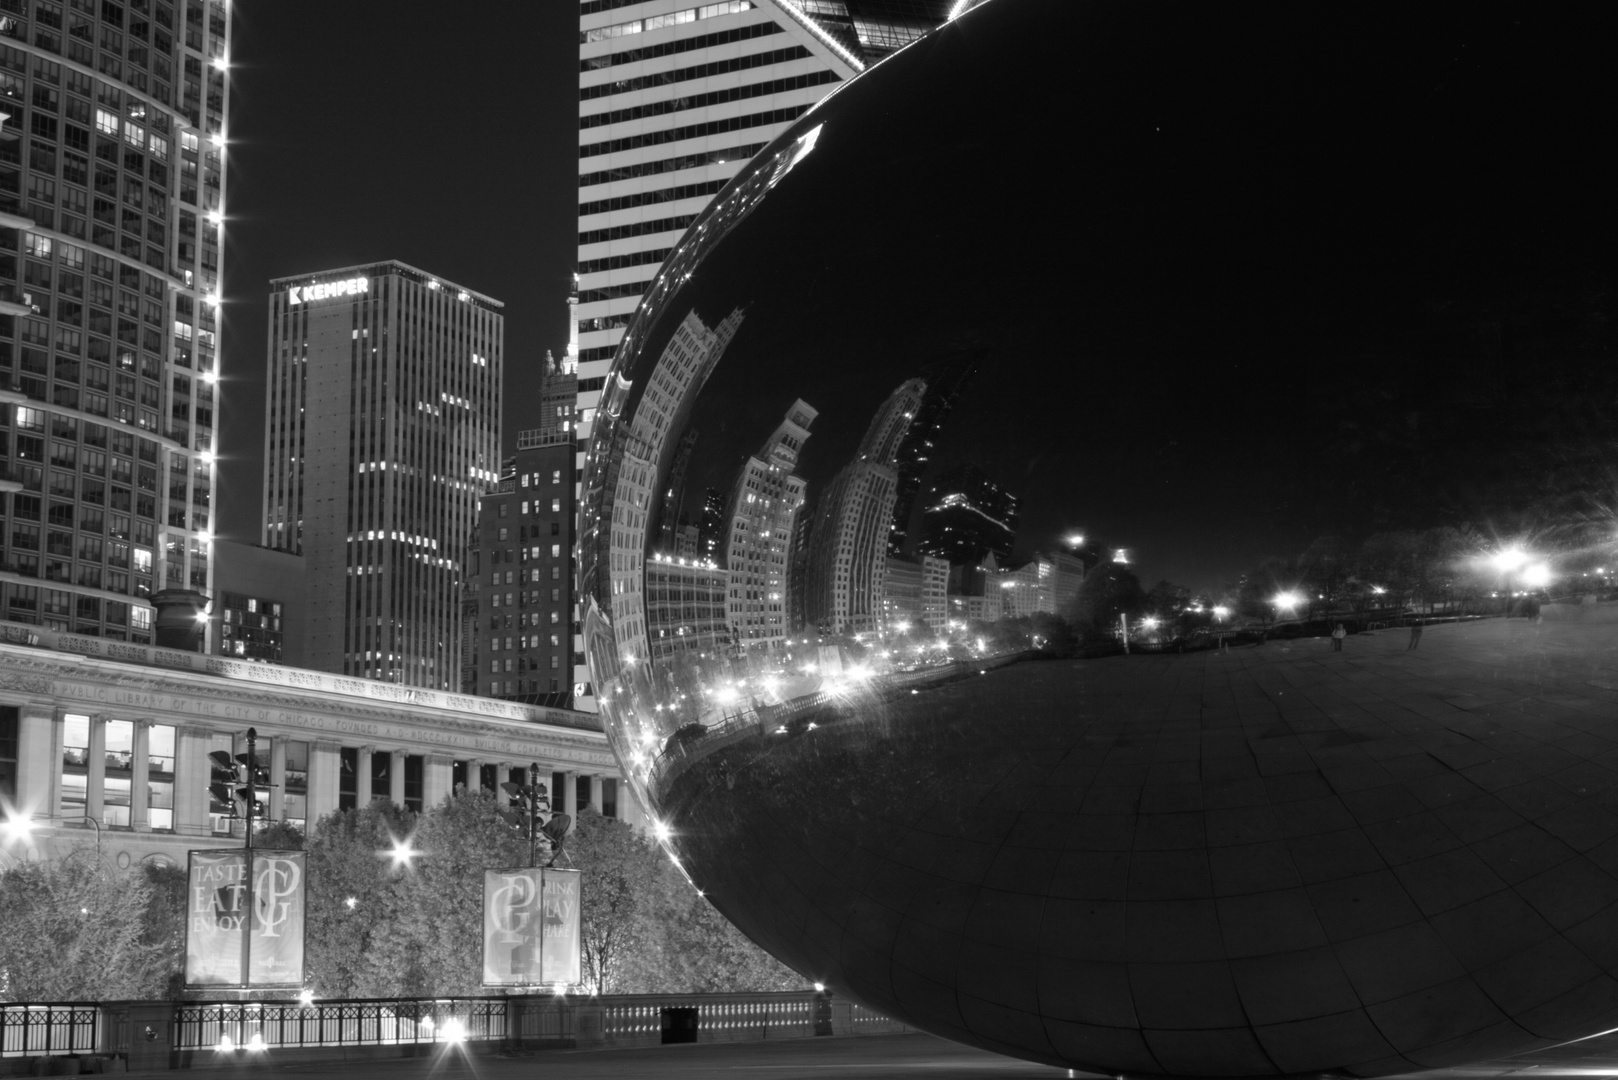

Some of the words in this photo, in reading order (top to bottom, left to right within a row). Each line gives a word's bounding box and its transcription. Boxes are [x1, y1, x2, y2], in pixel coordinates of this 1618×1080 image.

[303, 277, 369, 302] KEMPER
[62, 684, 105, 700] PVBLIC
[115, 693, 163, 707] LIBRARY
[173, 700, 186, 710] OF
[197, 702, 216, 714] THE
[225, 706, 250, 718] CITY
[258, 710, 271, 721] OF
[279, 712, 324, 728] CHICAGO
[194, 863, 247, 883] TASTE
[194, 885, 247, 912] EAT
[194, 915, 246, 937] ENJOY
